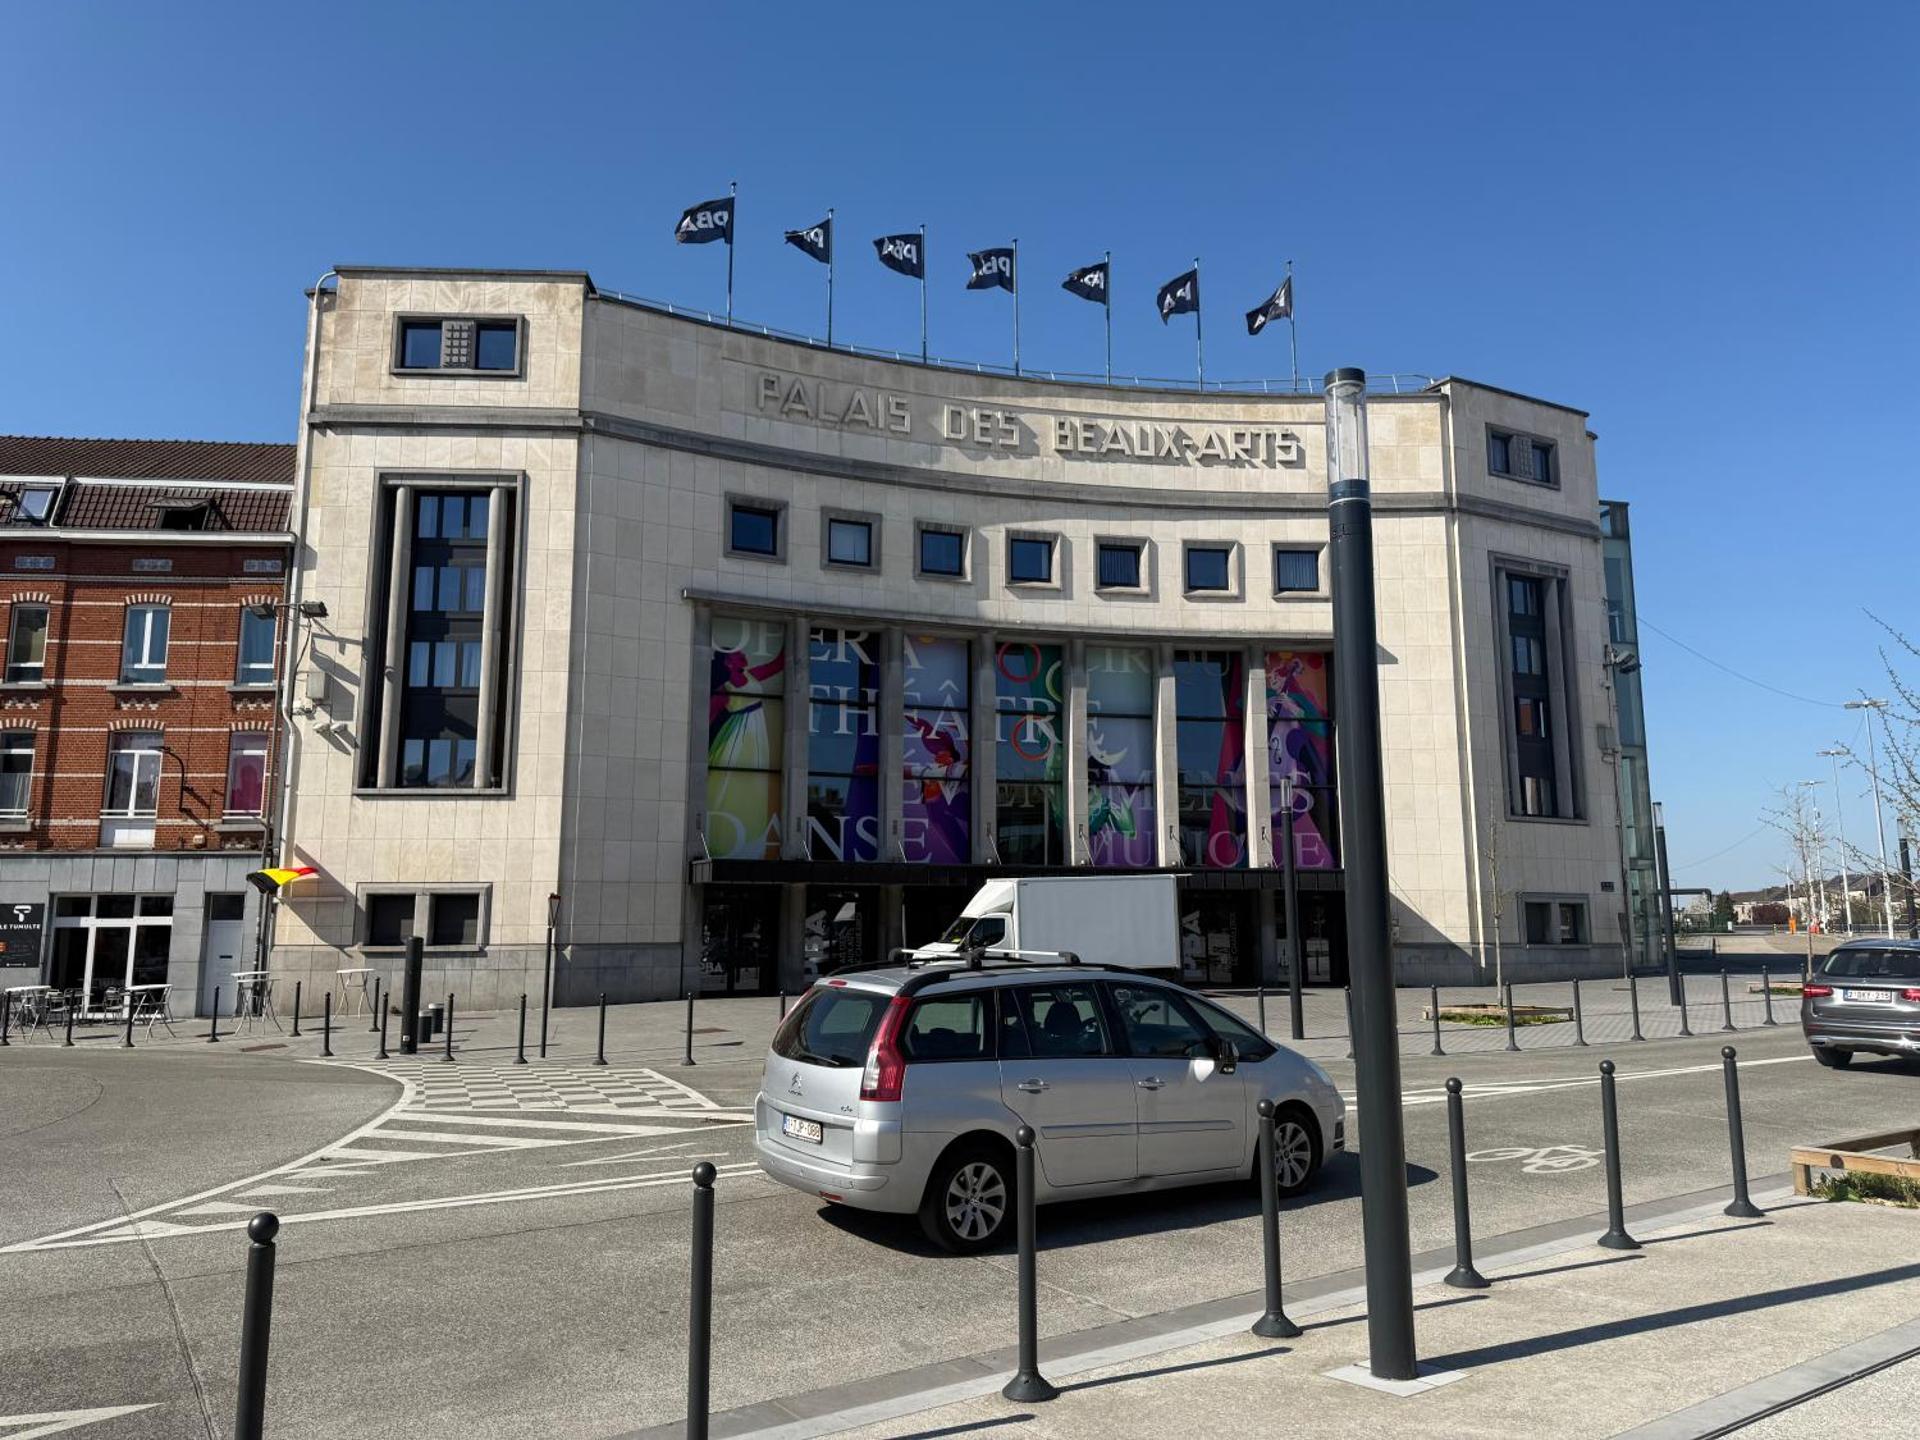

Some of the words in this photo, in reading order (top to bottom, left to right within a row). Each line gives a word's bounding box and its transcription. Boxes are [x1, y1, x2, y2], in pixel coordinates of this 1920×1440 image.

[758, 372, 911, 434] PALAIS
[943, 403, 1020, 446] DES
[1053, 416, 1299, 463] BEAUX-ARTS
[706, 812, 934, 864] DANSE
[9, 923, 41, 931] TUMULTE
